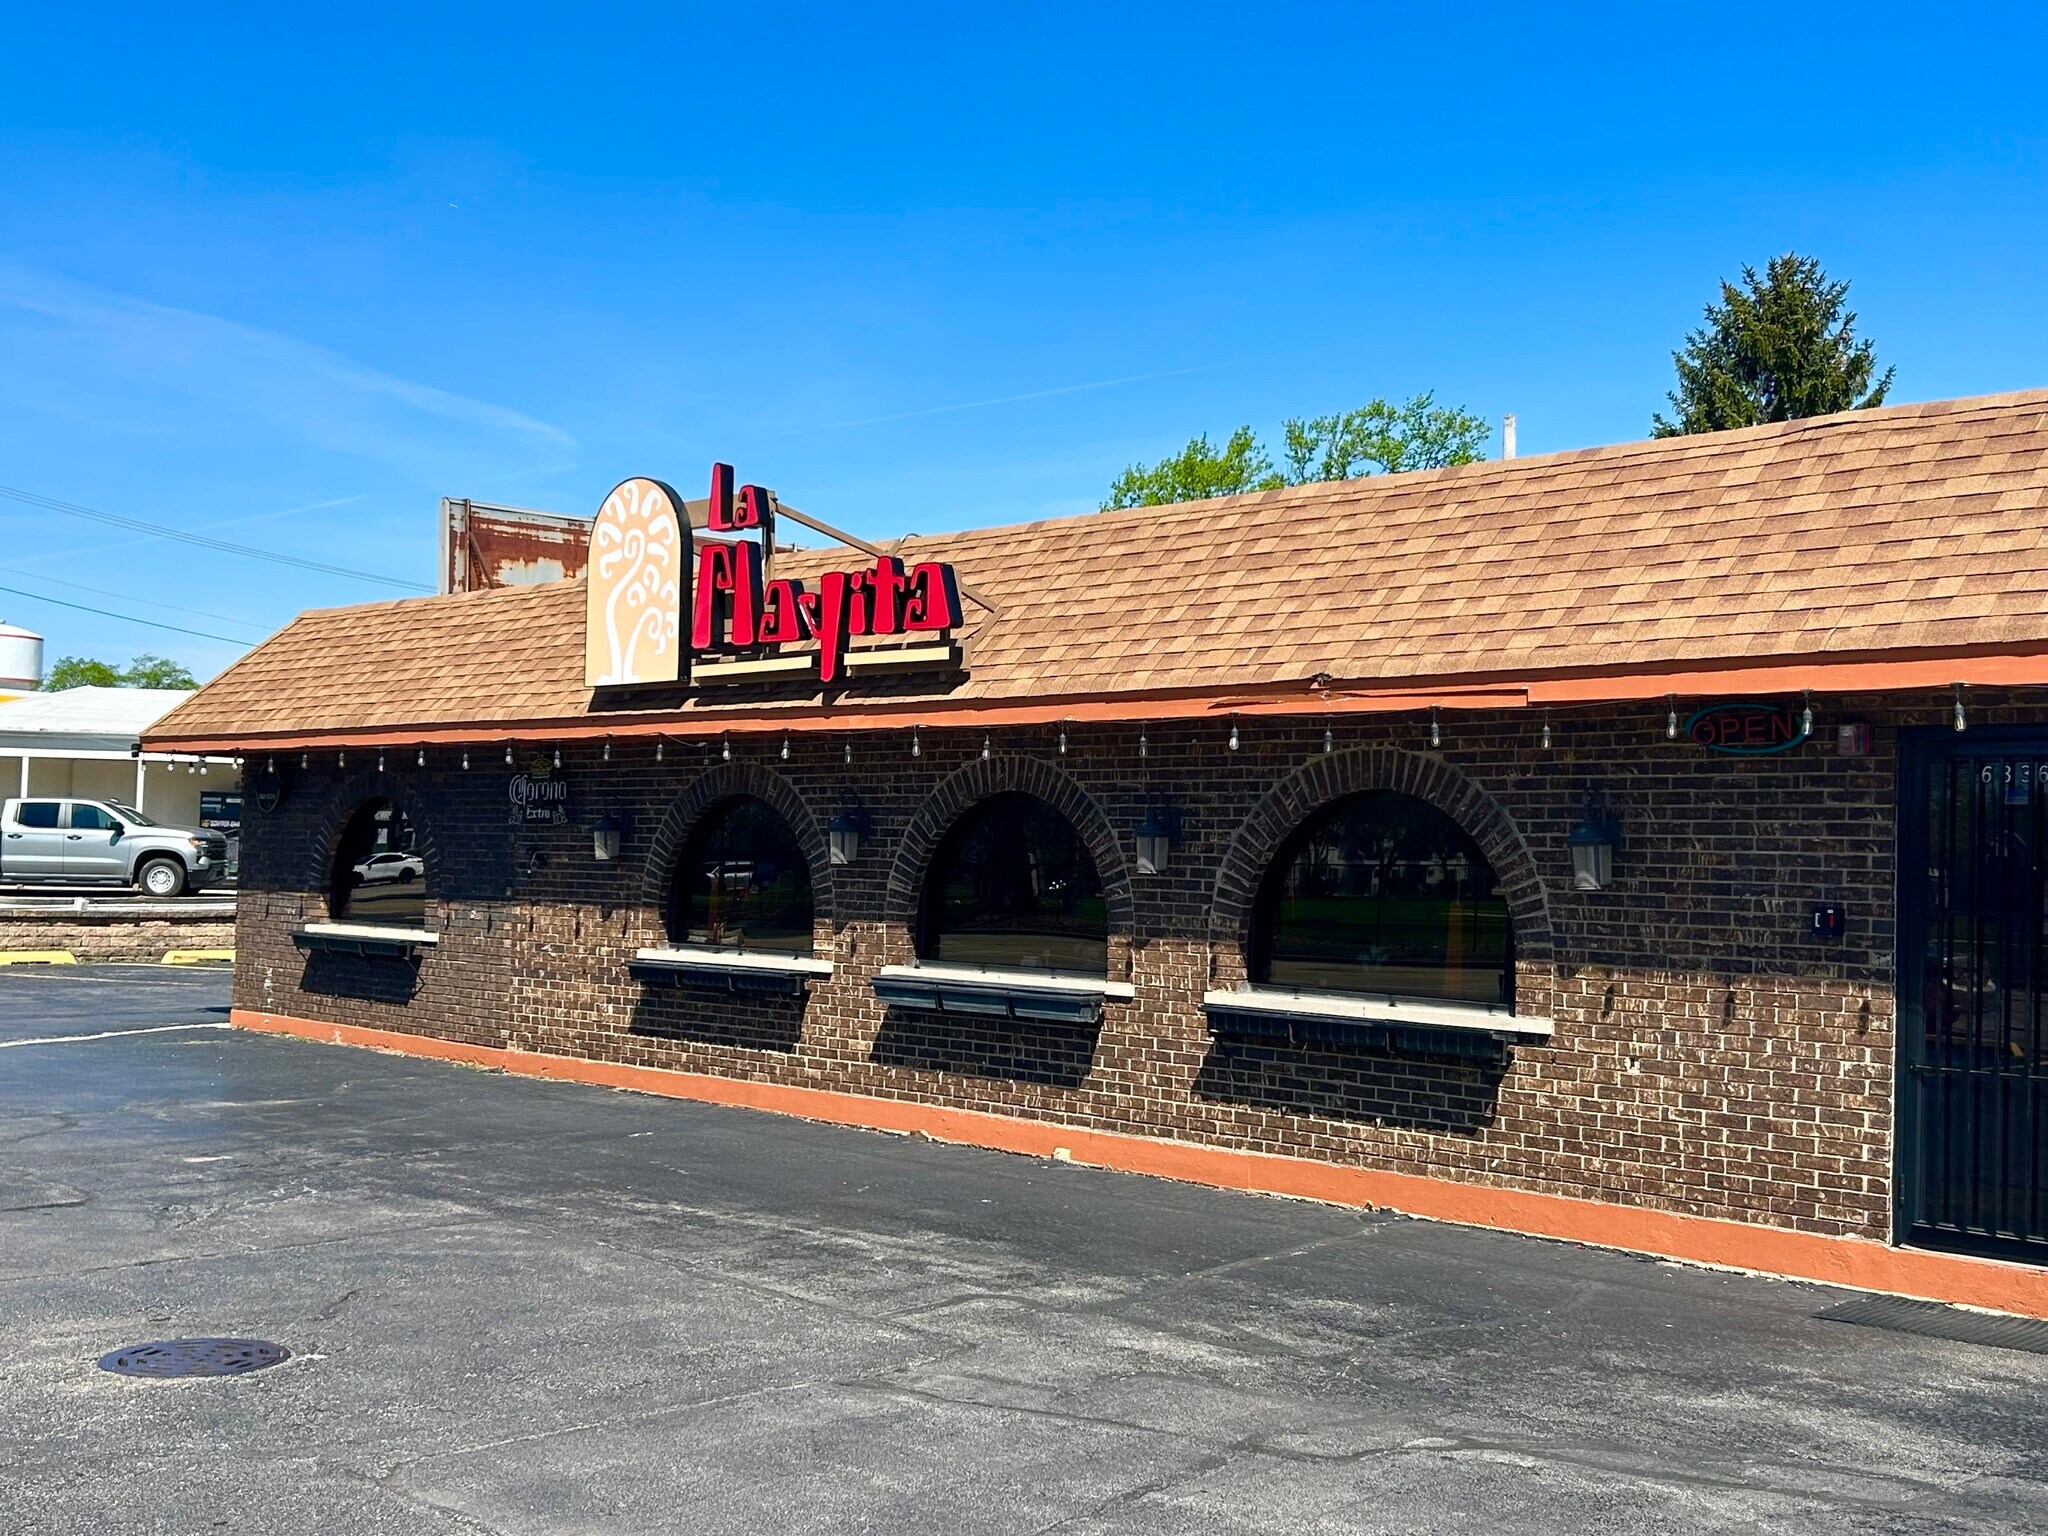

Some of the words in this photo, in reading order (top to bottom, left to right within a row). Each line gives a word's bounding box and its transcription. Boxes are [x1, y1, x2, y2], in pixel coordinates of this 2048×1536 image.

[708, 463, 769, 532] La
[1691, 713, 1793, 746] OPEN
[509, 775, 567, 806] Corona
[526, 805, 550, 819] Extra
